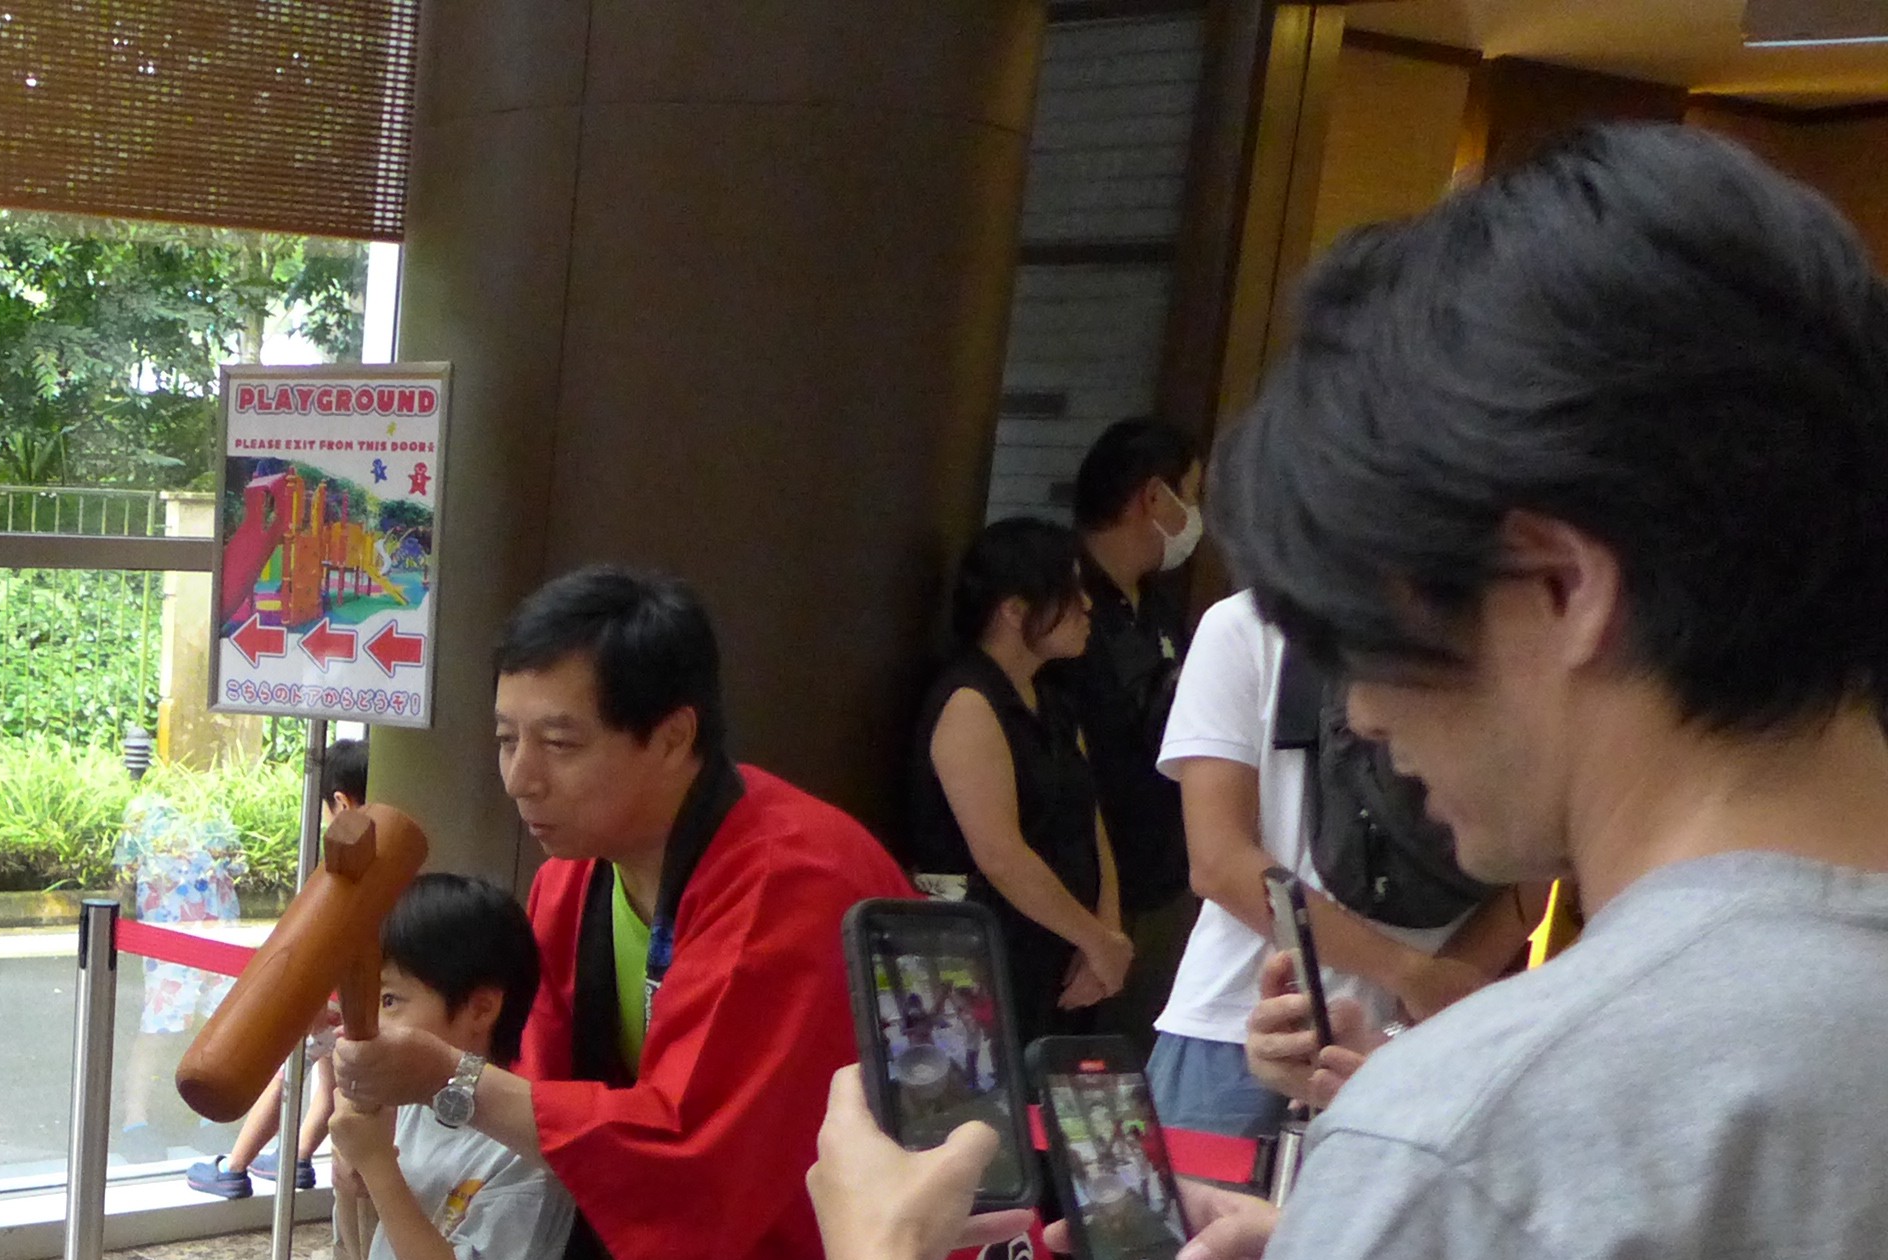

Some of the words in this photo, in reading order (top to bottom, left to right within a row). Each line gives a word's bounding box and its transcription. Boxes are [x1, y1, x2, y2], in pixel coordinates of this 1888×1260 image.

[237, 384, 438, 416] PLAYGROUND
[235, 438, 281, 449] PLEASE
[285, 439, 316, 450] EXIT
[358, 440, 386, 451] THIS
